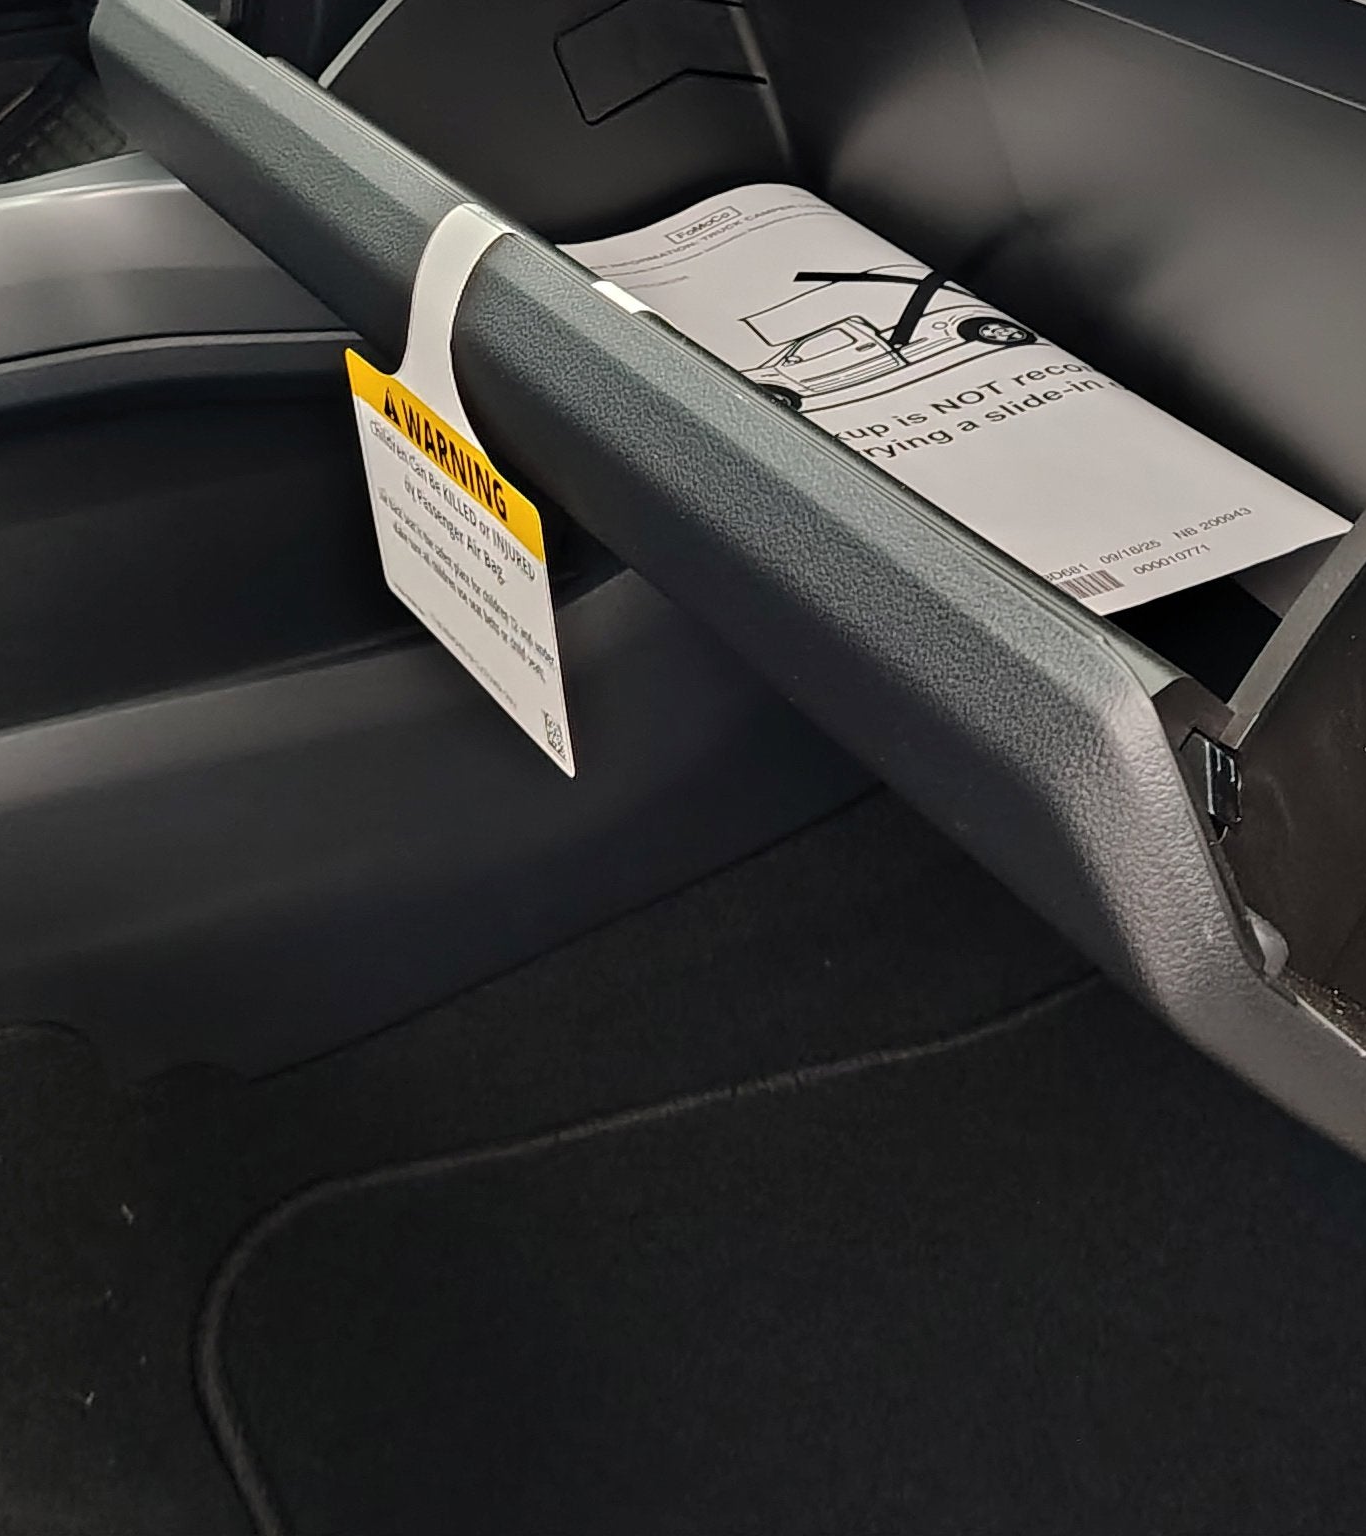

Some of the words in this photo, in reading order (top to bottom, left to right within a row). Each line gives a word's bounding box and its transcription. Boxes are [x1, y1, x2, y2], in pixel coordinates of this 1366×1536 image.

[675, 212, 730, 239] FoMoCo
[860, 428, 954, 459] rying
[956, 419, 979, 432] a
[984, 379, 1105, 424] slide-in
[891, 412, 927, 427] is
[931, 381, 1005, 415] NOT
[1011, 363, 1092, 387] reco
[401, 398, 508, 523] WARNING
[408, 452, 426, 481] Can
[427, 470, 440, 494] Be
[441, 484, 476, 527] KILLED
[478, 519, 491, 541] or
[491, 527, 536, 584] INJURED
[416, 487, 465, 548] Passenger
[464, 532, 482, 561] Air
[1099, 540, 1161, 565] 09/18/25
